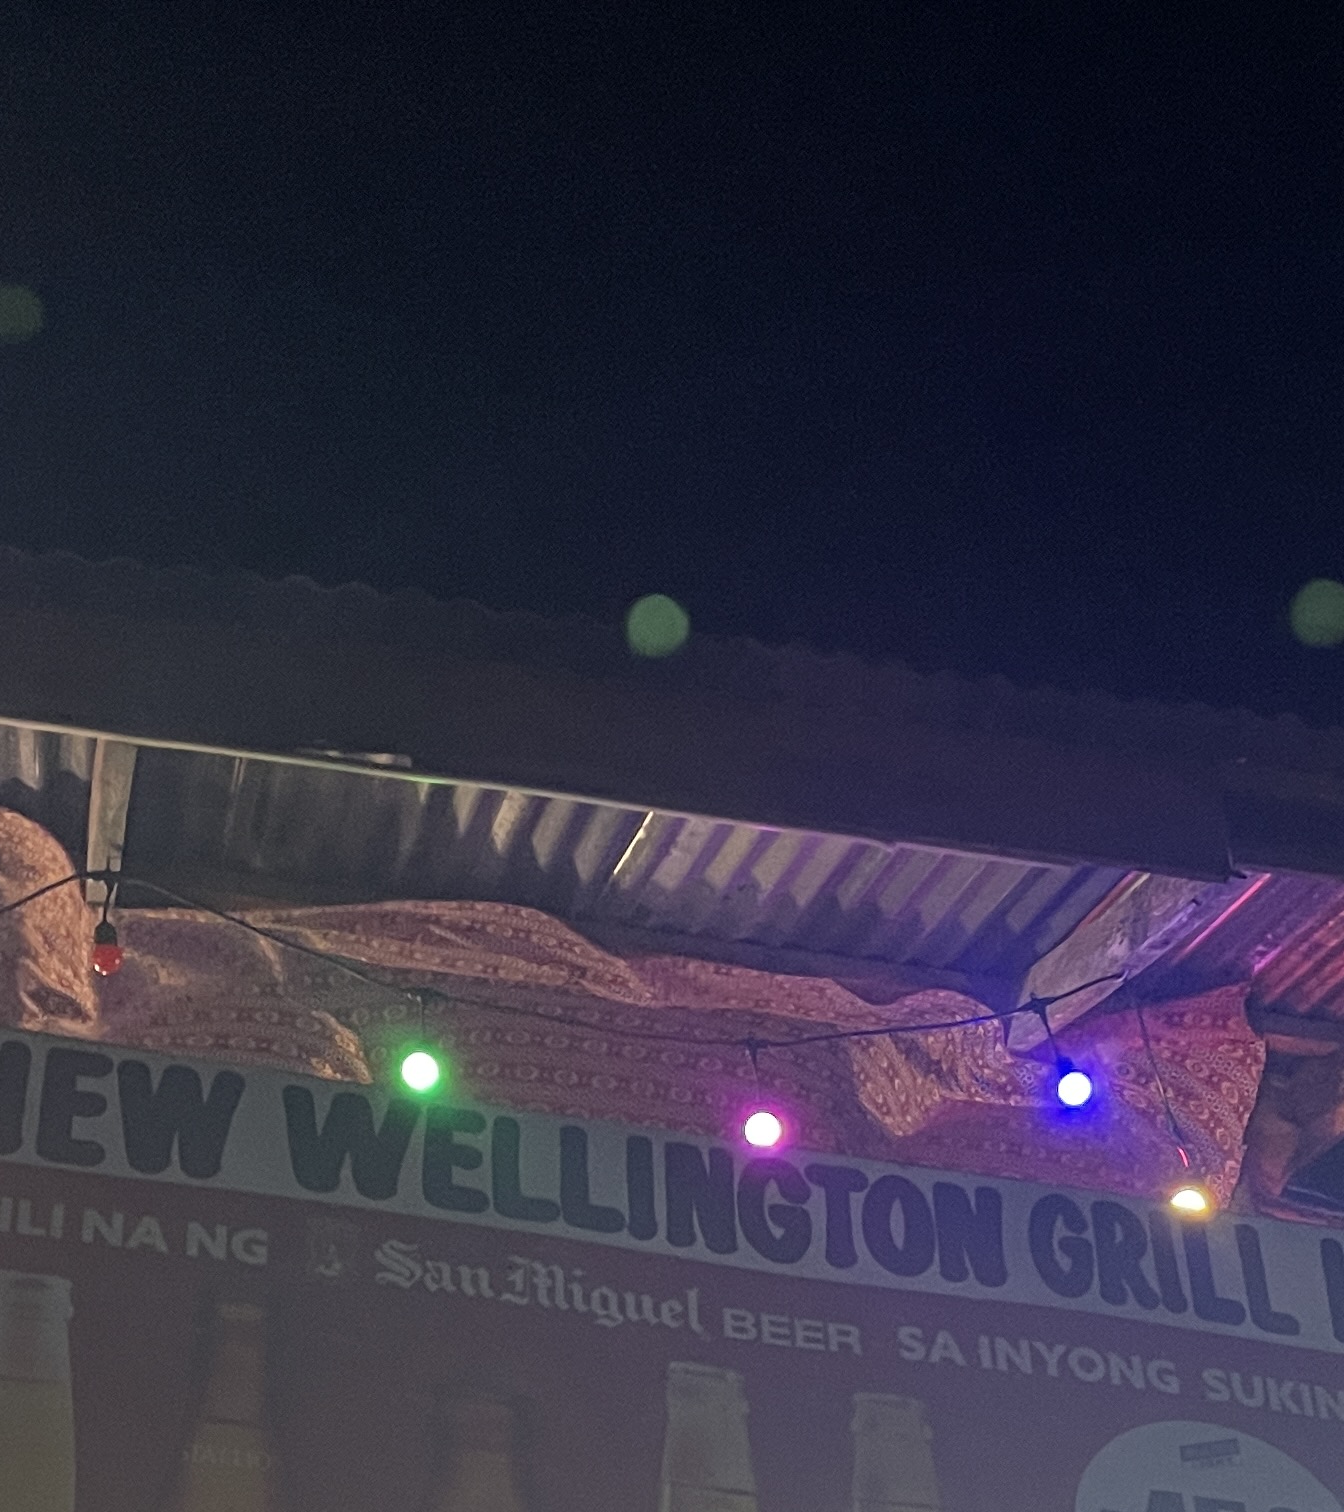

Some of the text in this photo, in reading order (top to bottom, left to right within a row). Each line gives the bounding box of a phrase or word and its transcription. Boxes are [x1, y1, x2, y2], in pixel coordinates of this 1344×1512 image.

[81, 1205, 167, 1255] NA
[186, 1220, 269, 1264] NG
[374, 1239, 495, 1301] San
[498, 1255, 706, 1334] Miguel
[723, 1311, 861, 1354] BEER
[898, 1325, 965, 1369] SA
[979, 1337, 1179, 1395] INYONG
[282, 1083, 1006, 1286] WELLINGTON
[1028, 1203, 1298, 1334] GRILL
